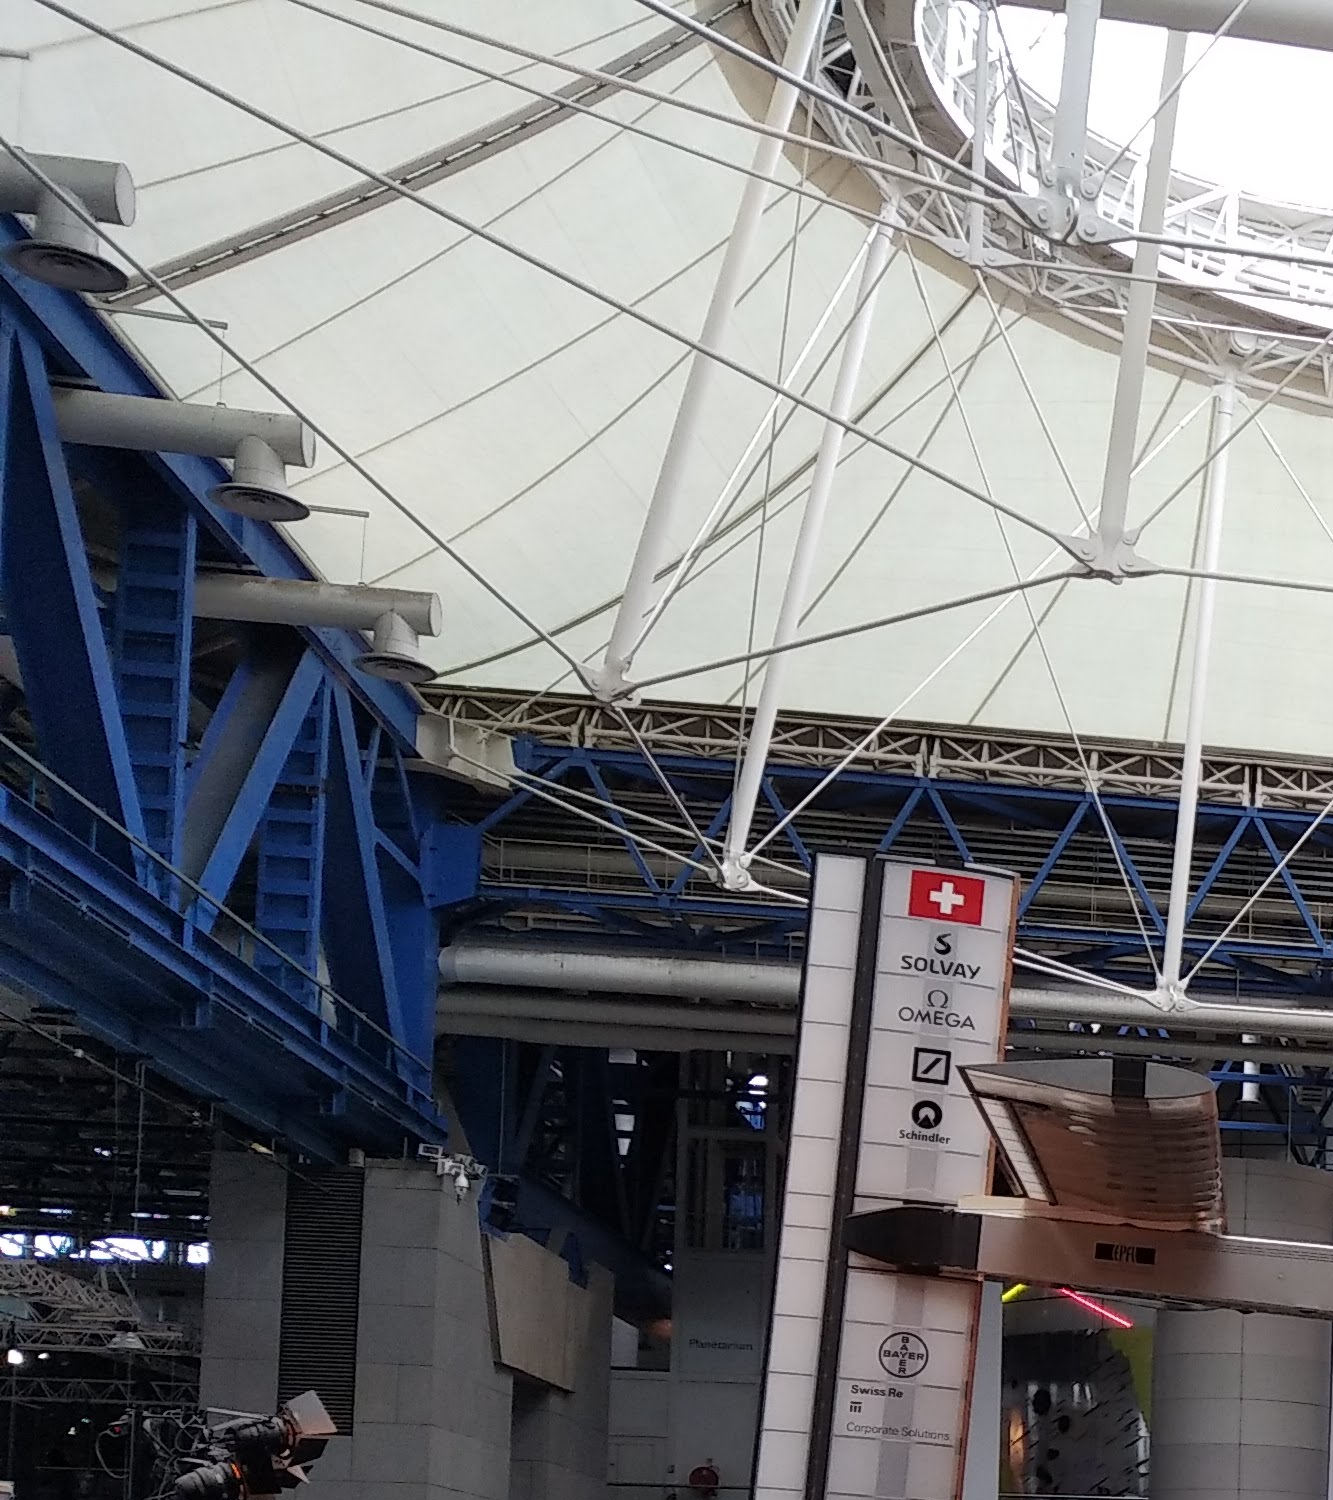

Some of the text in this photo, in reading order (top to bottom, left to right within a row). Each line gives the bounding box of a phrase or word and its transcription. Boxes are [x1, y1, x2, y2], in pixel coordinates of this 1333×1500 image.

[901, 955, 981, 980] SOLVAY
[898, 1006, 976, 1031] OMEGA
[899, 1129, 951, 1145] Schindler
[883, 1350, 924, 1361] BAYER
[850, 1384, 904, 1399] Swiss Re
[846, 1422, 950, 1441] Corporate Solutions
